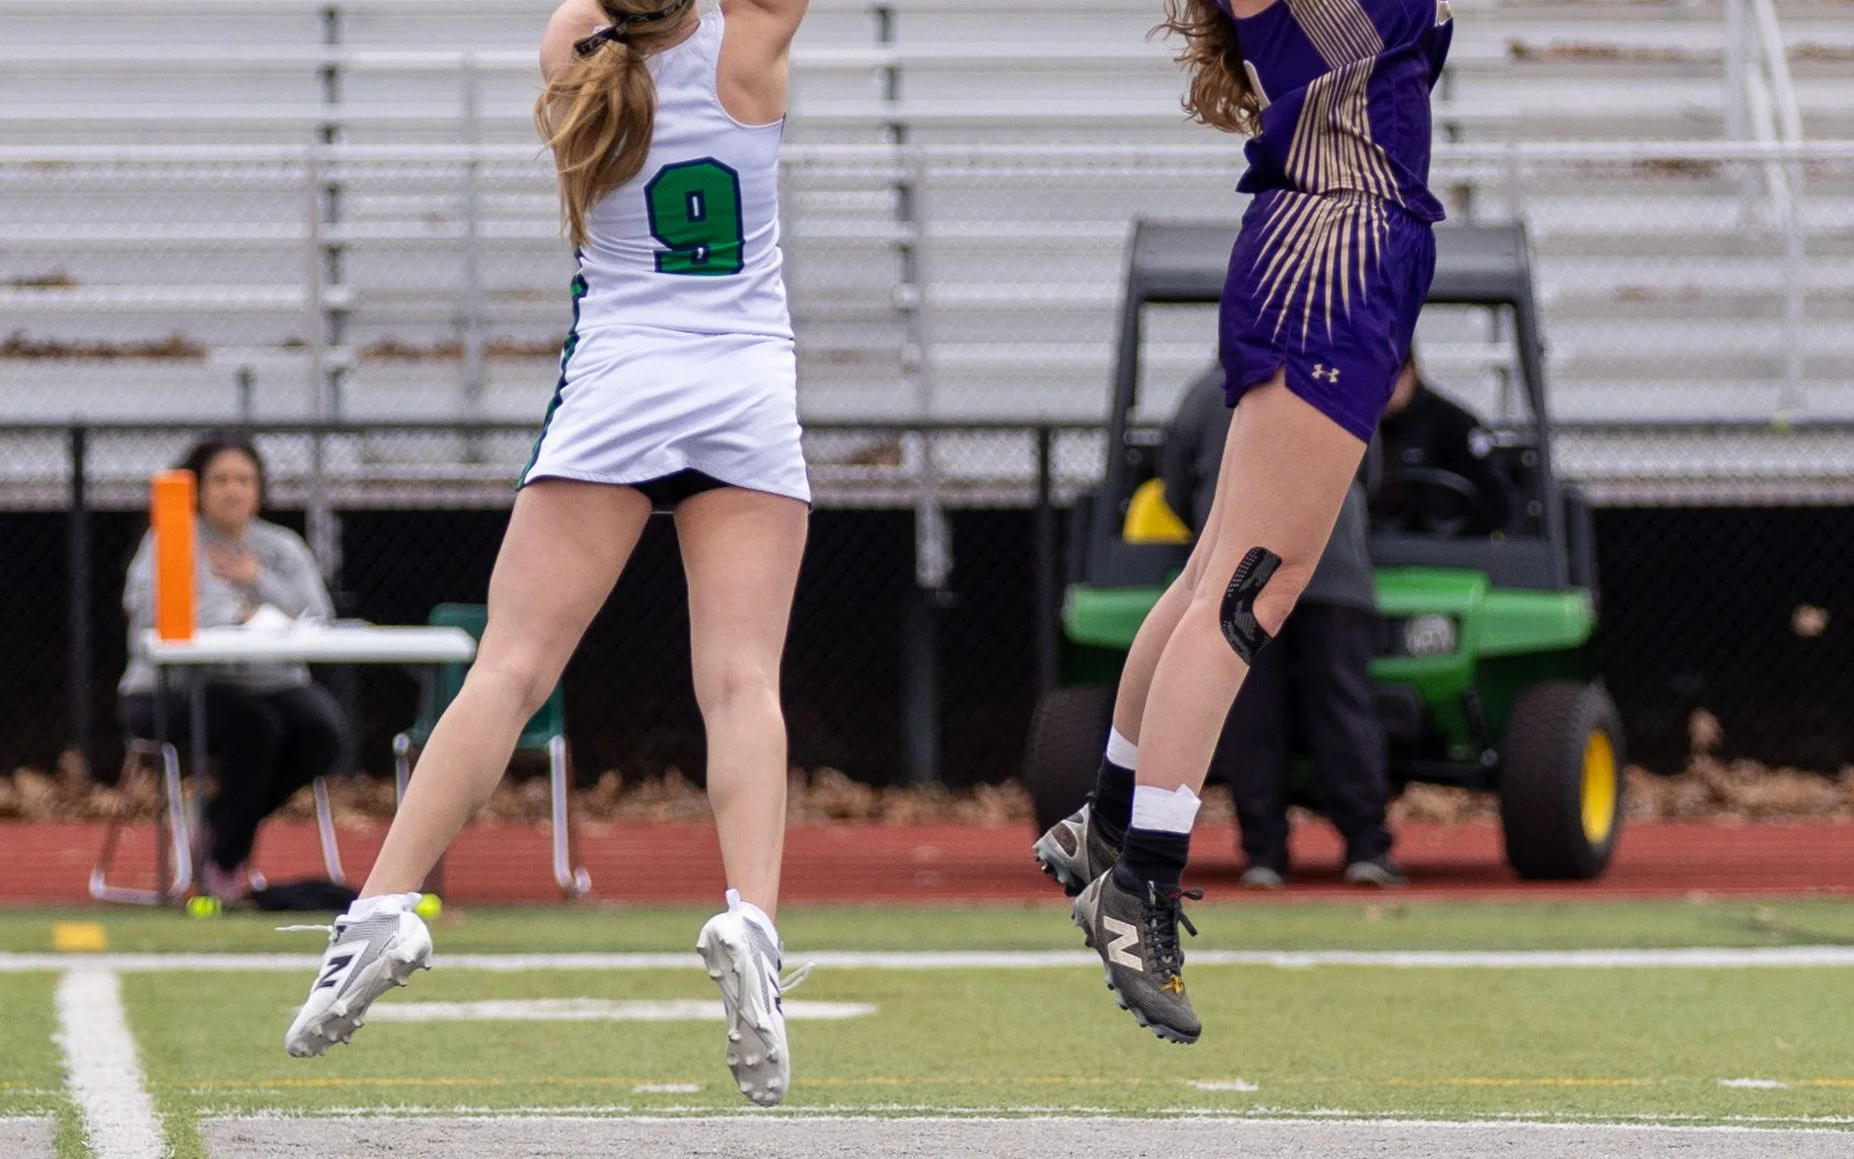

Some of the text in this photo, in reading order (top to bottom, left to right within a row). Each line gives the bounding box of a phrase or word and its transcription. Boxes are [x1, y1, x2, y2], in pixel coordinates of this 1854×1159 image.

[643, 155, 746, 277] 9
[1103, 915, 1144, 972] N
[315, 954, 356, 991] N
